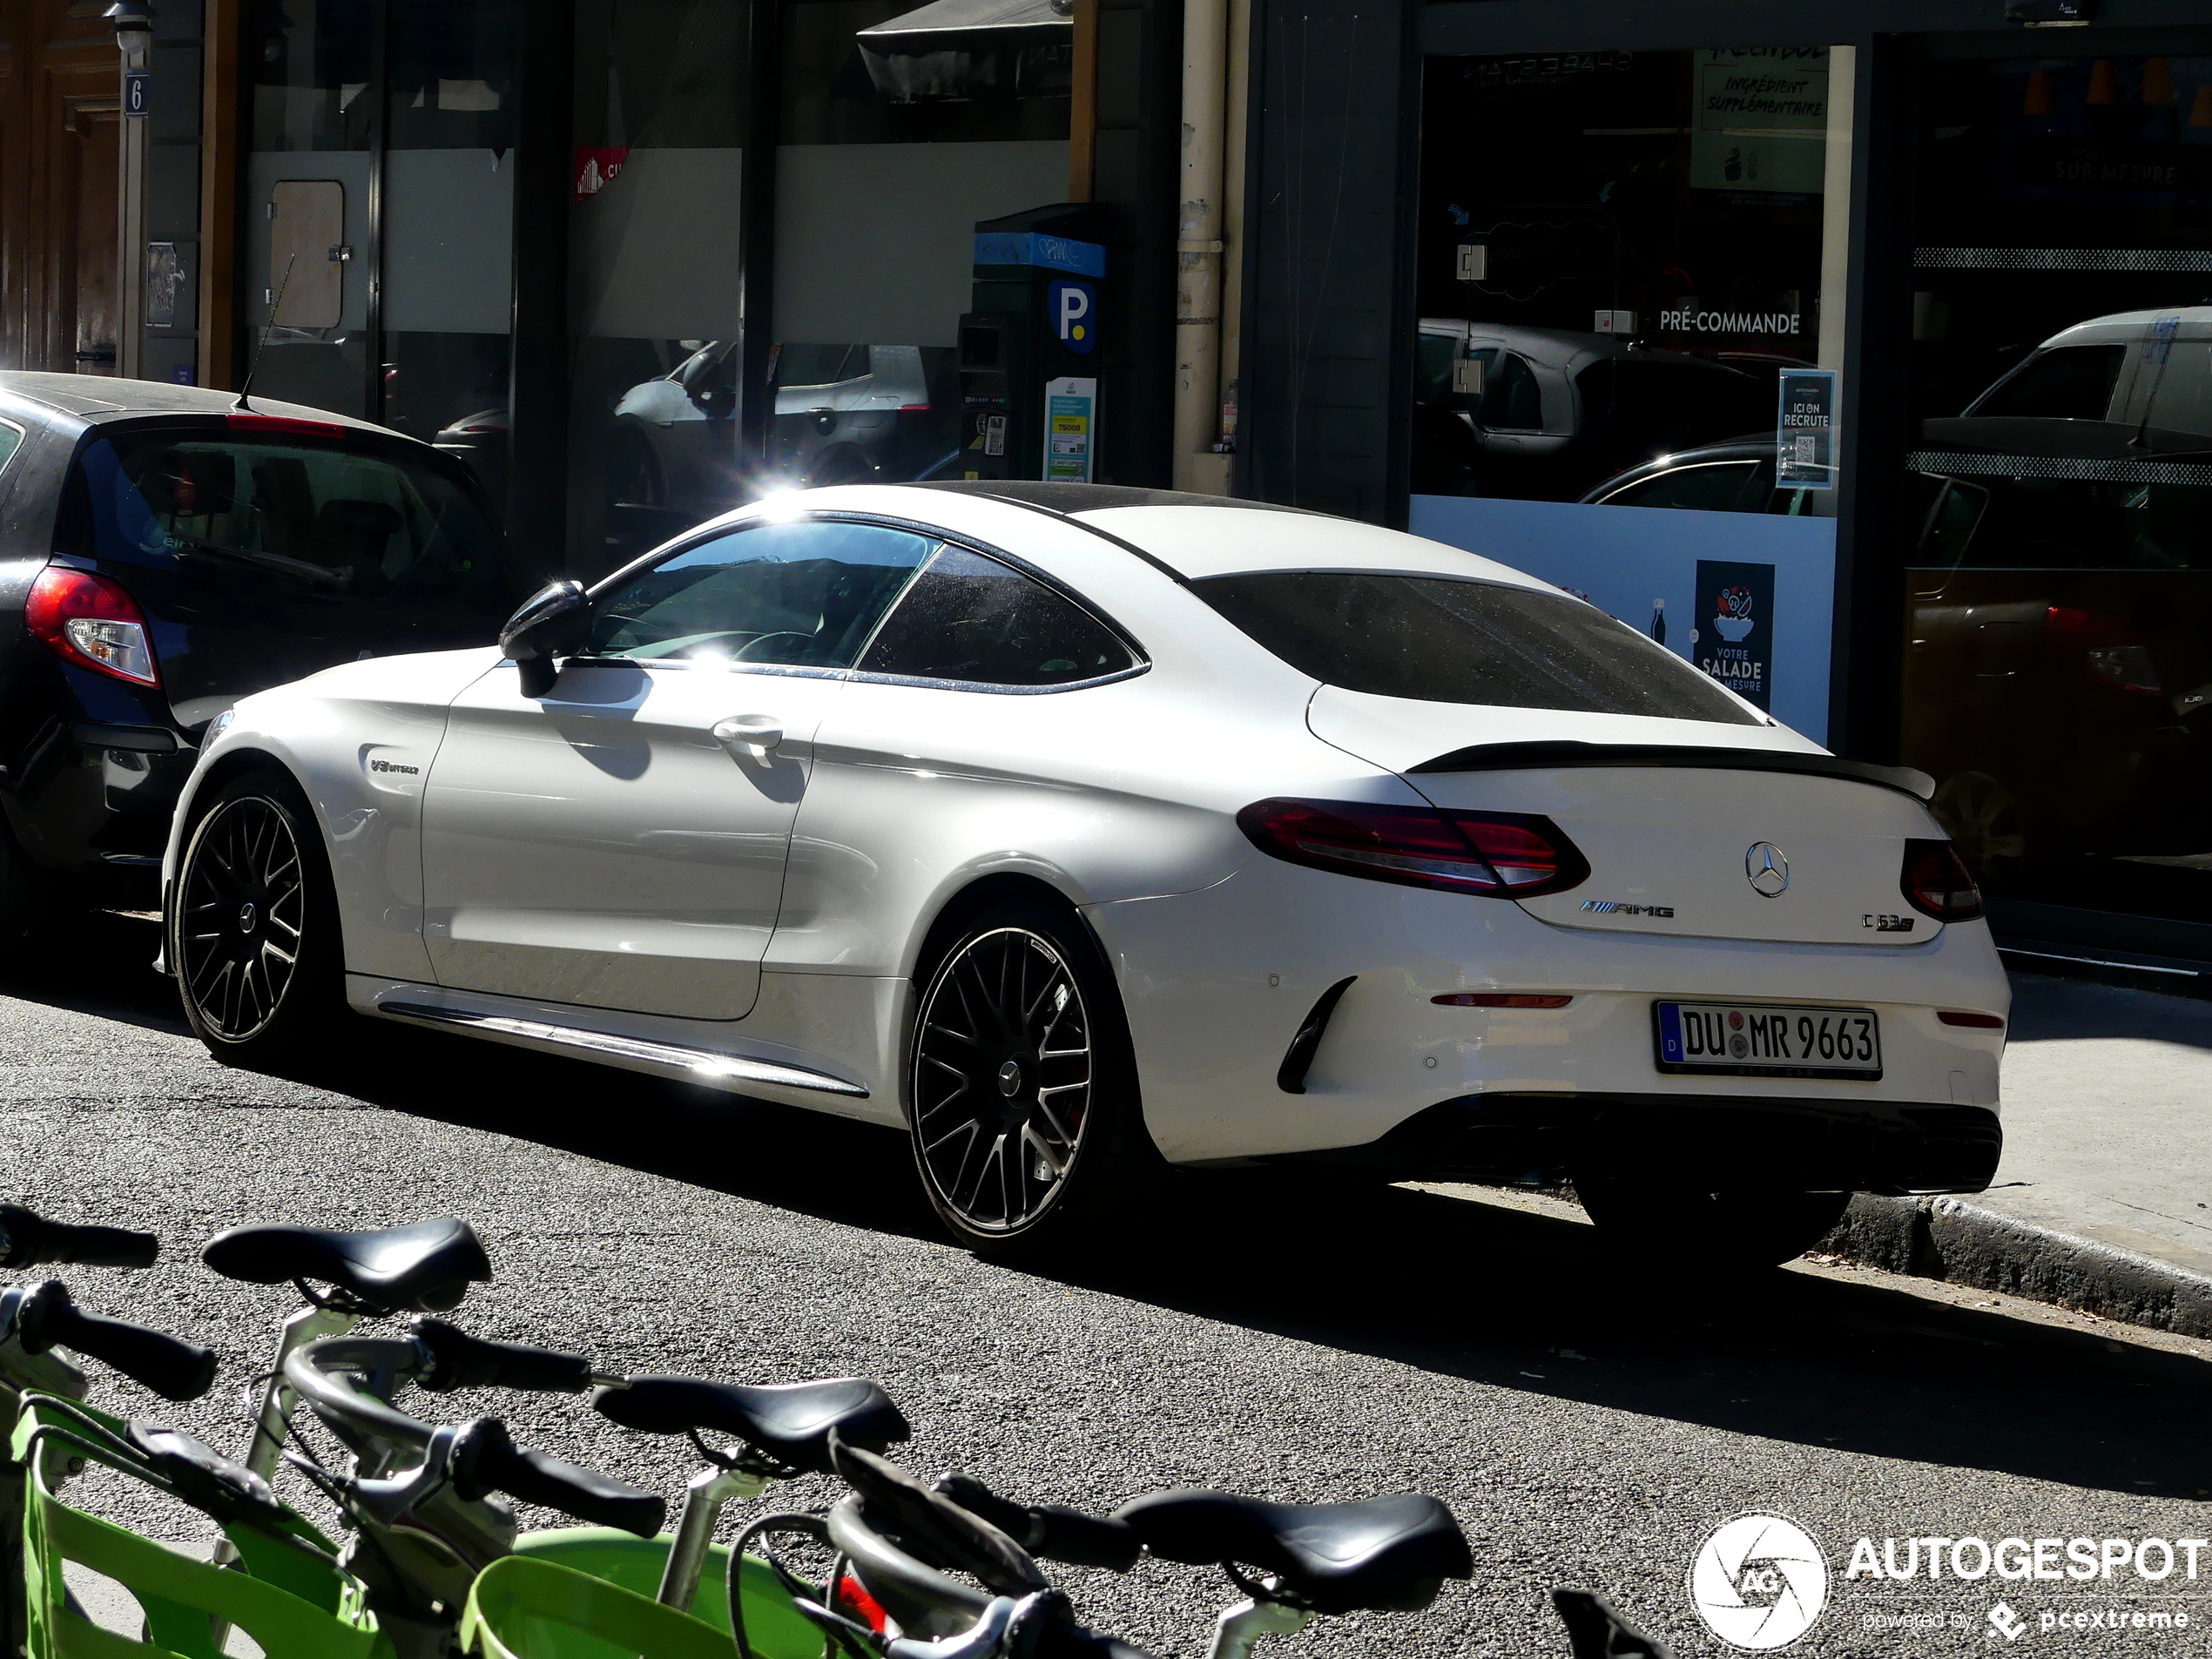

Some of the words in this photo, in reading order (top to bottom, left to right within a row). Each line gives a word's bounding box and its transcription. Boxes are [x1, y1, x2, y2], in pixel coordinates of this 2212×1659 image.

[1725, 74, 1810, 94] INGRÉDIENT
[132, 79, 142, 110] 6
[1707, 93, 1824, 117] SUPPLÉMENTAIRE
[1060, 287, 1089, 340] P
[1660, 305, 1801, 335] PRÉ-COMMANDE
[1793, 403, 1804, 414] ICI
[1806, 403, 1820, 414] ON
[1058, 423, 1081, 432] 75008
[1784, 414, 1829, 427] RECRUTE
[1716, 647, 1749, 660] VOTRE
[1703, 658, 1762, 679] SALADE
[1724, 679, 1762, 691] MESURE
[1610, 902, 1675, 918] AMG
[1862, 914, 1873, 927] C
[1668, 1039, 1676, 1052] D
[1683, 1011, 1726, 1055] DU
[1749, 1014, 1791, 1057] MR
[1797, 1016, 1873, 1061] 9663
